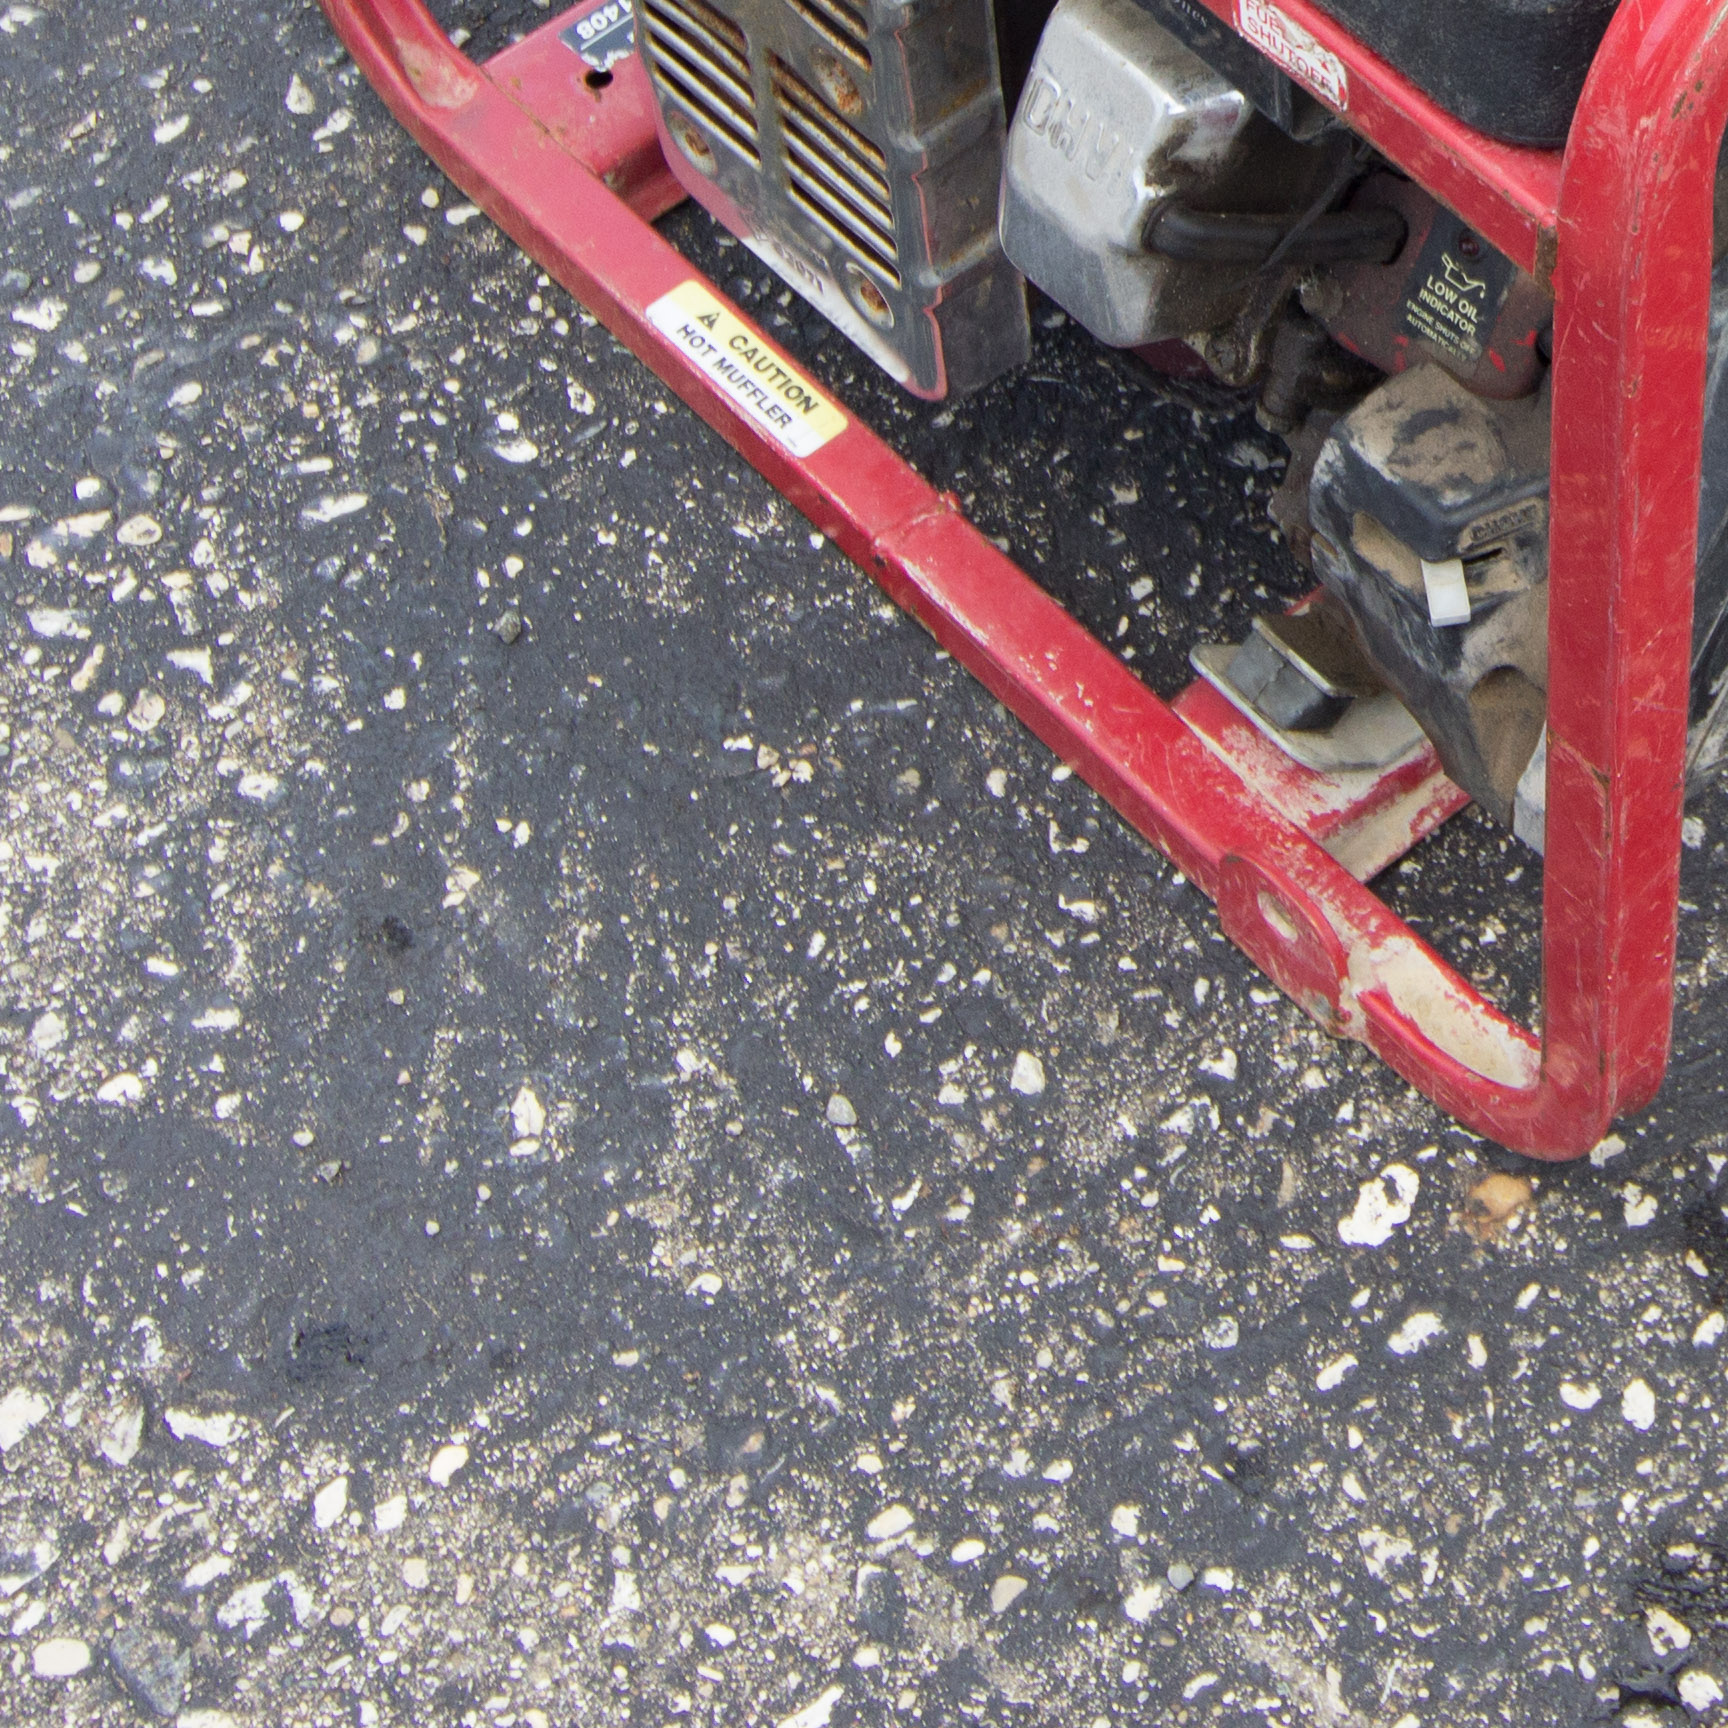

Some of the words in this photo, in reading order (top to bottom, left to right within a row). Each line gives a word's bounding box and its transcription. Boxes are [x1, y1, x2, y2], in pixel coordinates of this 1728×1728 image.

[1406, 298, 1436, 325] ENGINE
[1435, 322, 1461, 346] SHUTS
[1418, 287, 1477, 337] INDICATOR
[1426, 273, 1459, 305] LOW
[1458, 298, 1479, 324] OIL
[675, 323, 718, 357] HOT
[712, 355, 793, 430] MUFFLER
[728, 333, 820, 416] CAUTION
